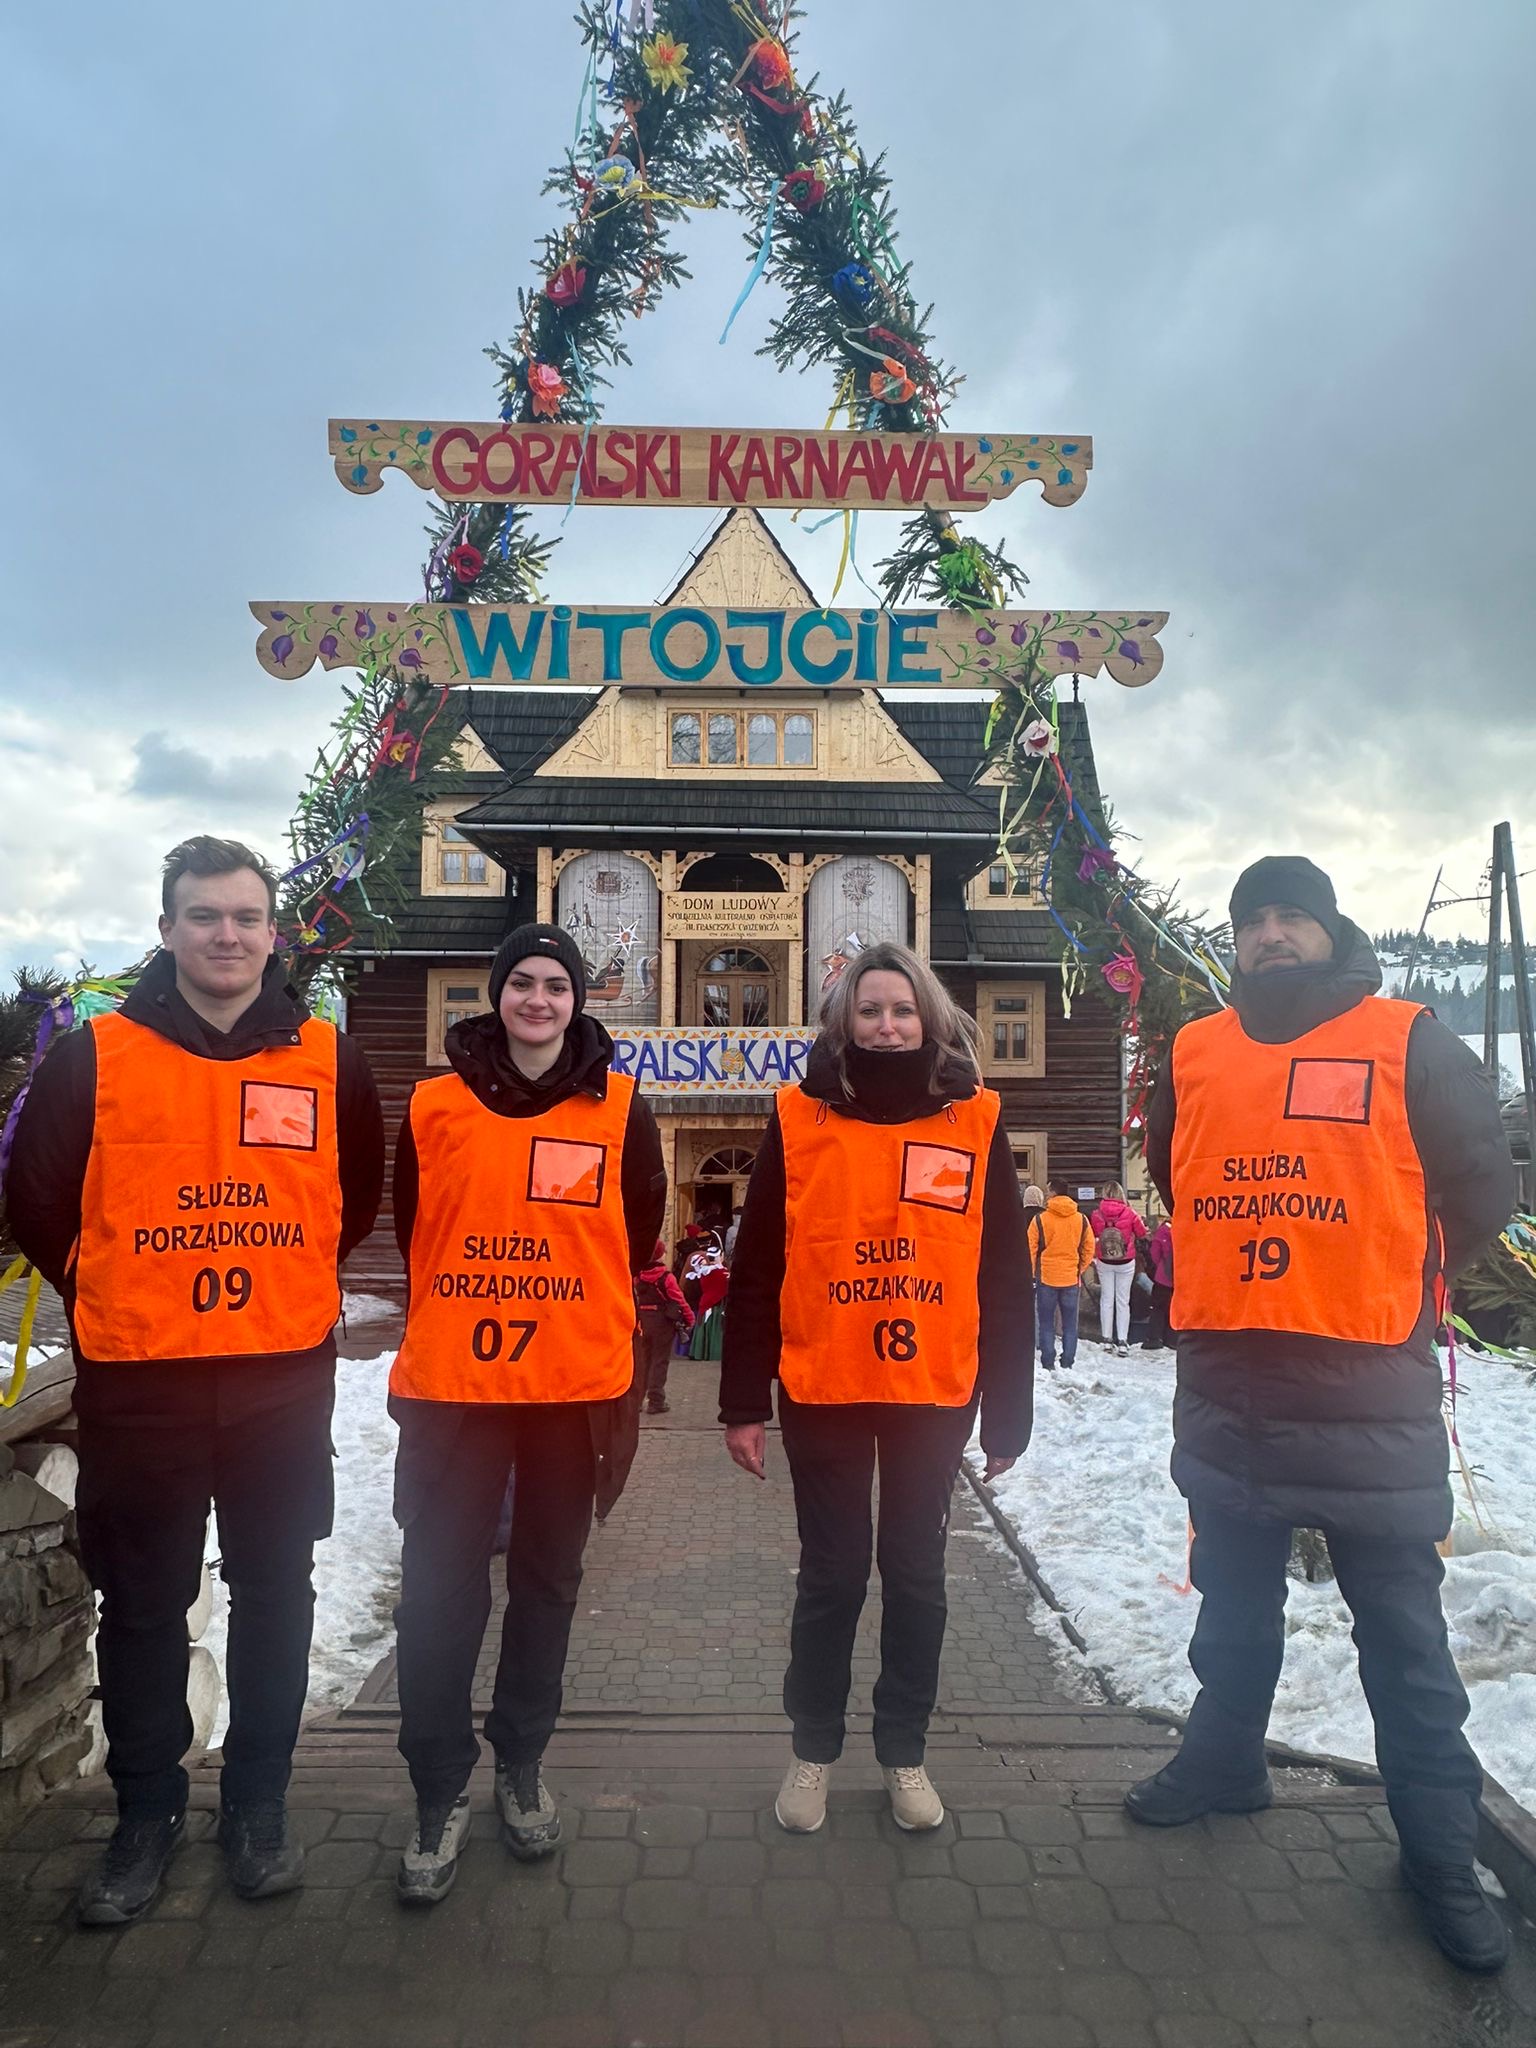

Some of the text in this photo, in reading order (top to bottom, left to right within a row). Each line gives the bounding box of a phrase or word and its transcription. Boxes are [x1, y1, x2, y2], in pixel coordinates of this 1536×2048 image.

[432, 423, 988, 504] GÓRALSKI KARNAWAŁ
[683, 896, 780, 910] DOM LUDOWY
[611, 1038, 813, 1081] RALSKI KAR
[1223, 1149, 1307, 1181] SŁUŻBA
[178, 1175, 269, 1210] SŁUŻBA
[134, 1221, 304, 1254] PORZĄDKOWA
[464, 1230, 551, 1262] SŁUŻBA
[1239, 1237, 1290, 1282] 19
[192, 1266, 253, 1313] 09
[431, 1273, 584, 1305] PORZĄDKOWA
[472, 1318, 538, 1362] 07
